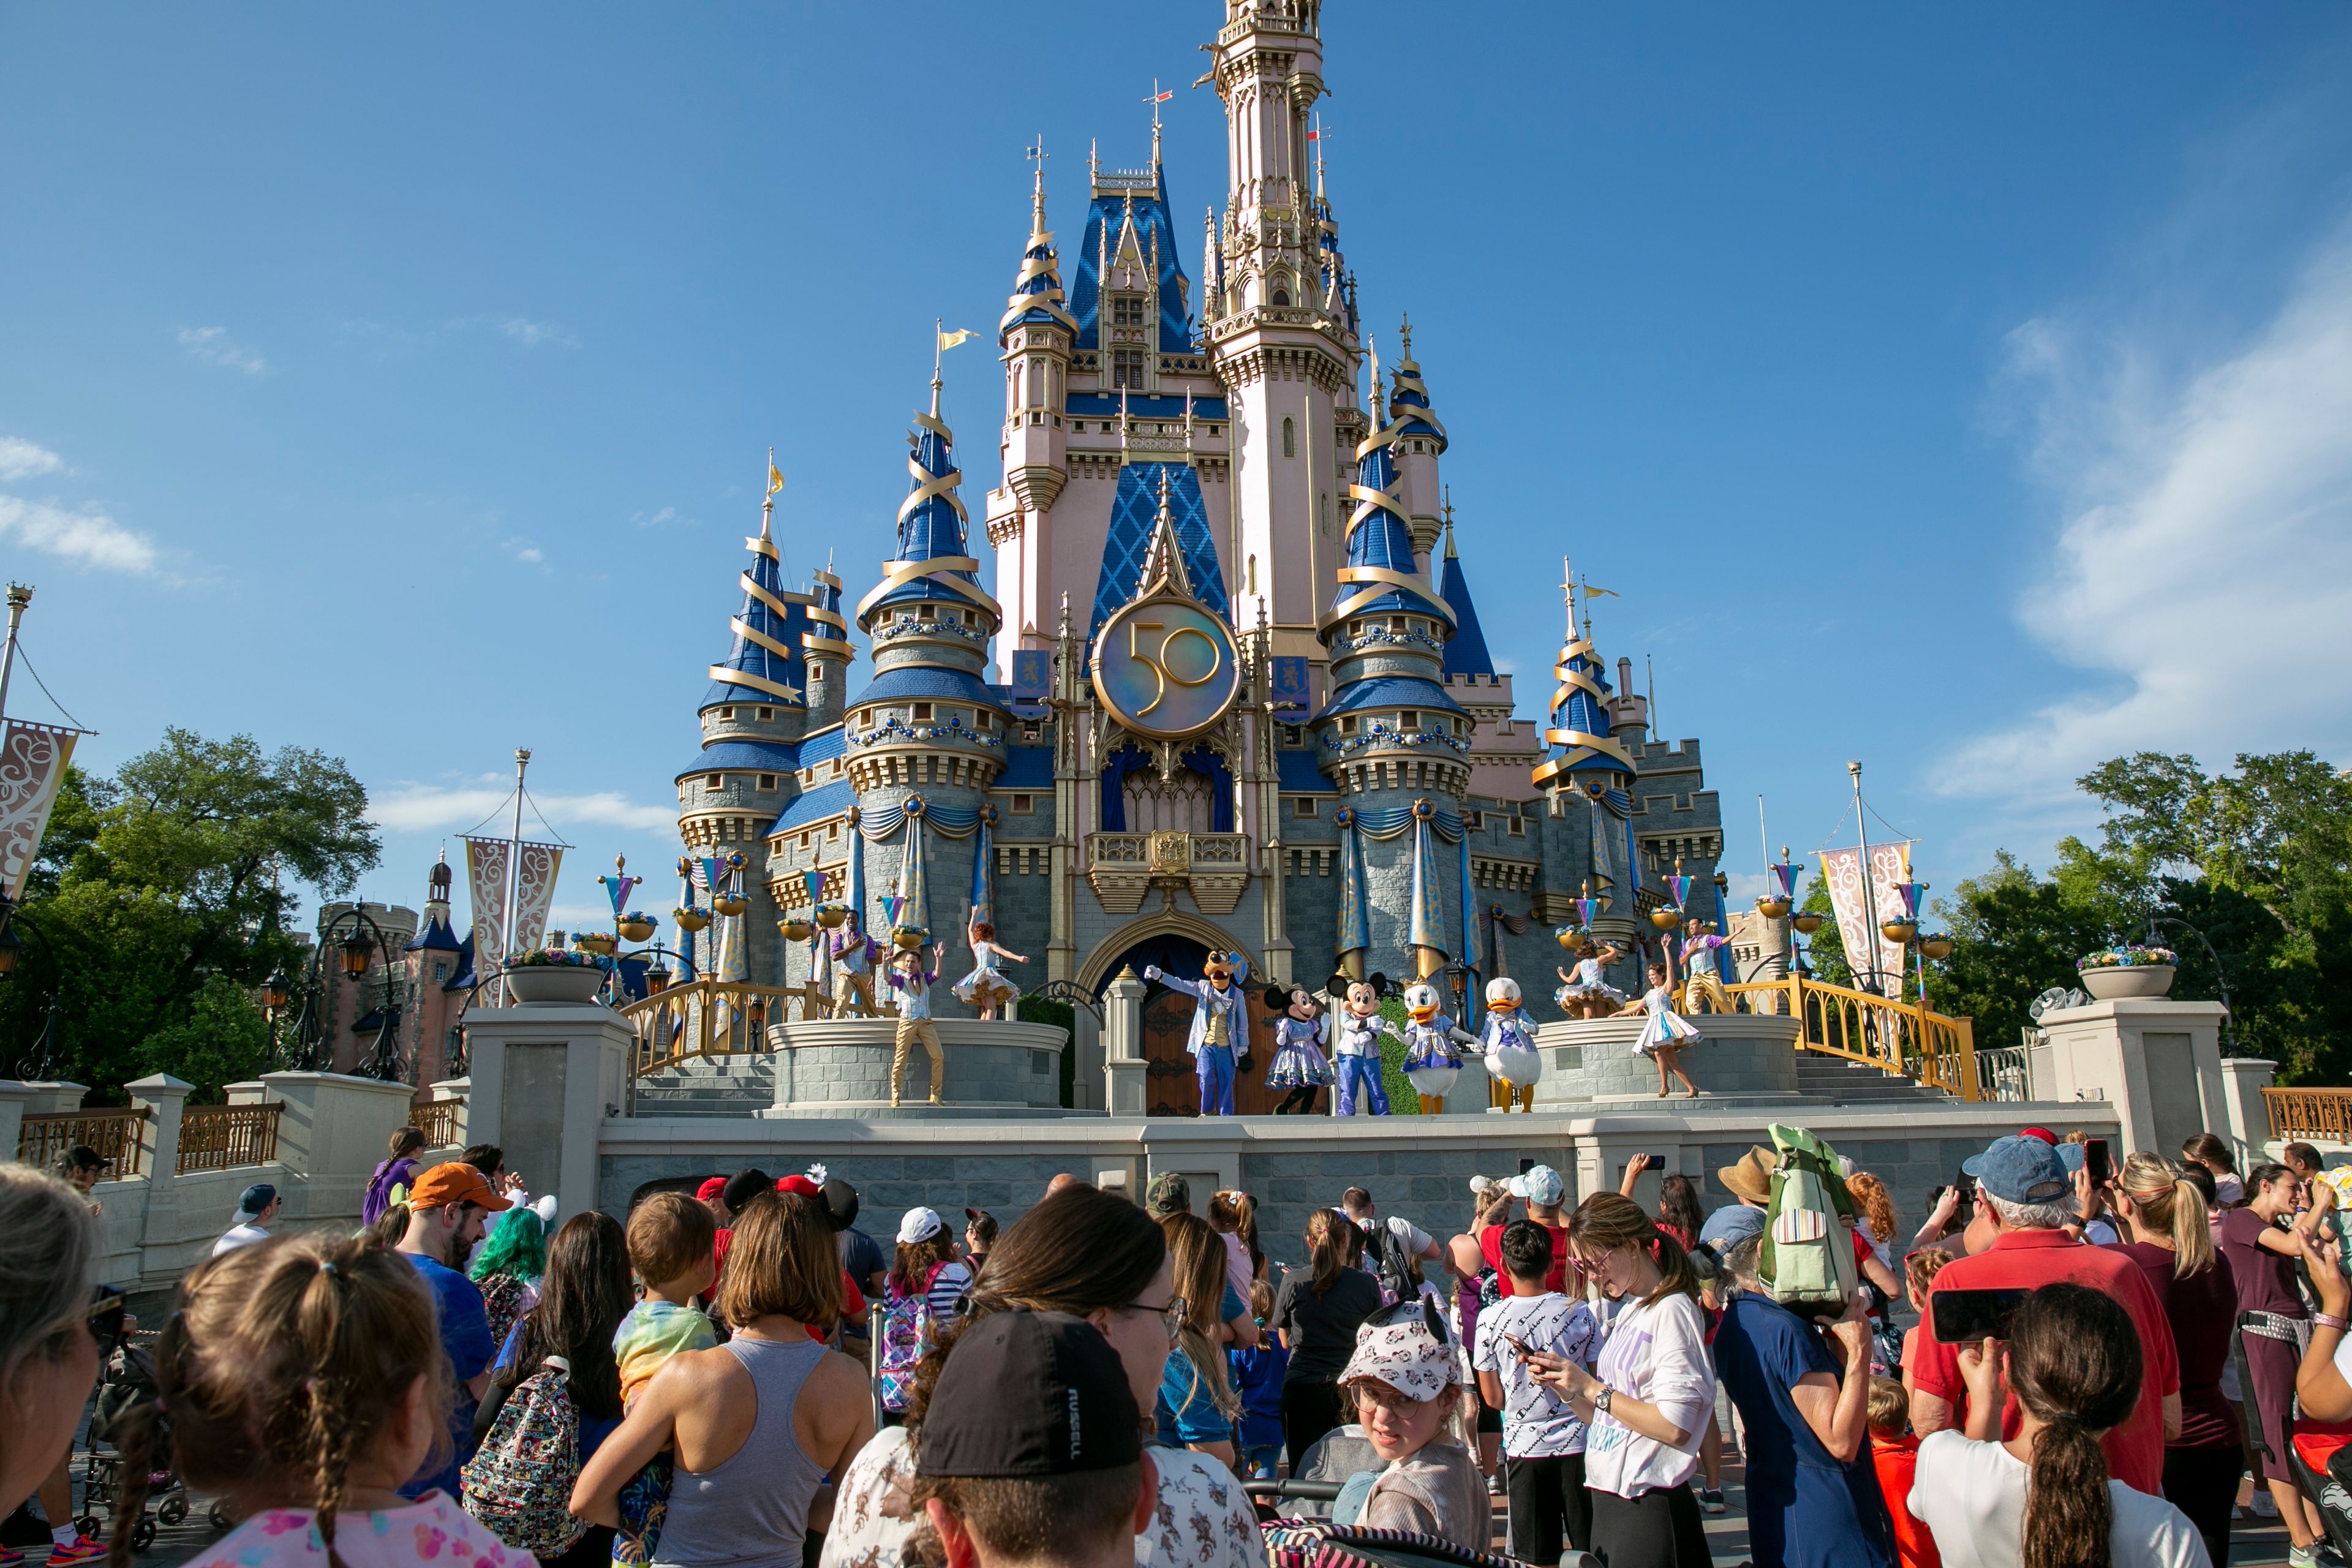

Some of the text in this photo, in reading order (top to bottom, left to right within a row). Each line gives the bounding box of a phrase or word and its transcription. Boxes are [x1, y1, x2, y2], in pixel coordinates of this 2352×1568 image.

[1130, 622, 1220, 717] 50
[1518, 1298, 1547, 1326] Champion
[1538, 1314, 1578, 1352] Champion
[1068, 1388, 1081, 1460] RUSSELL
